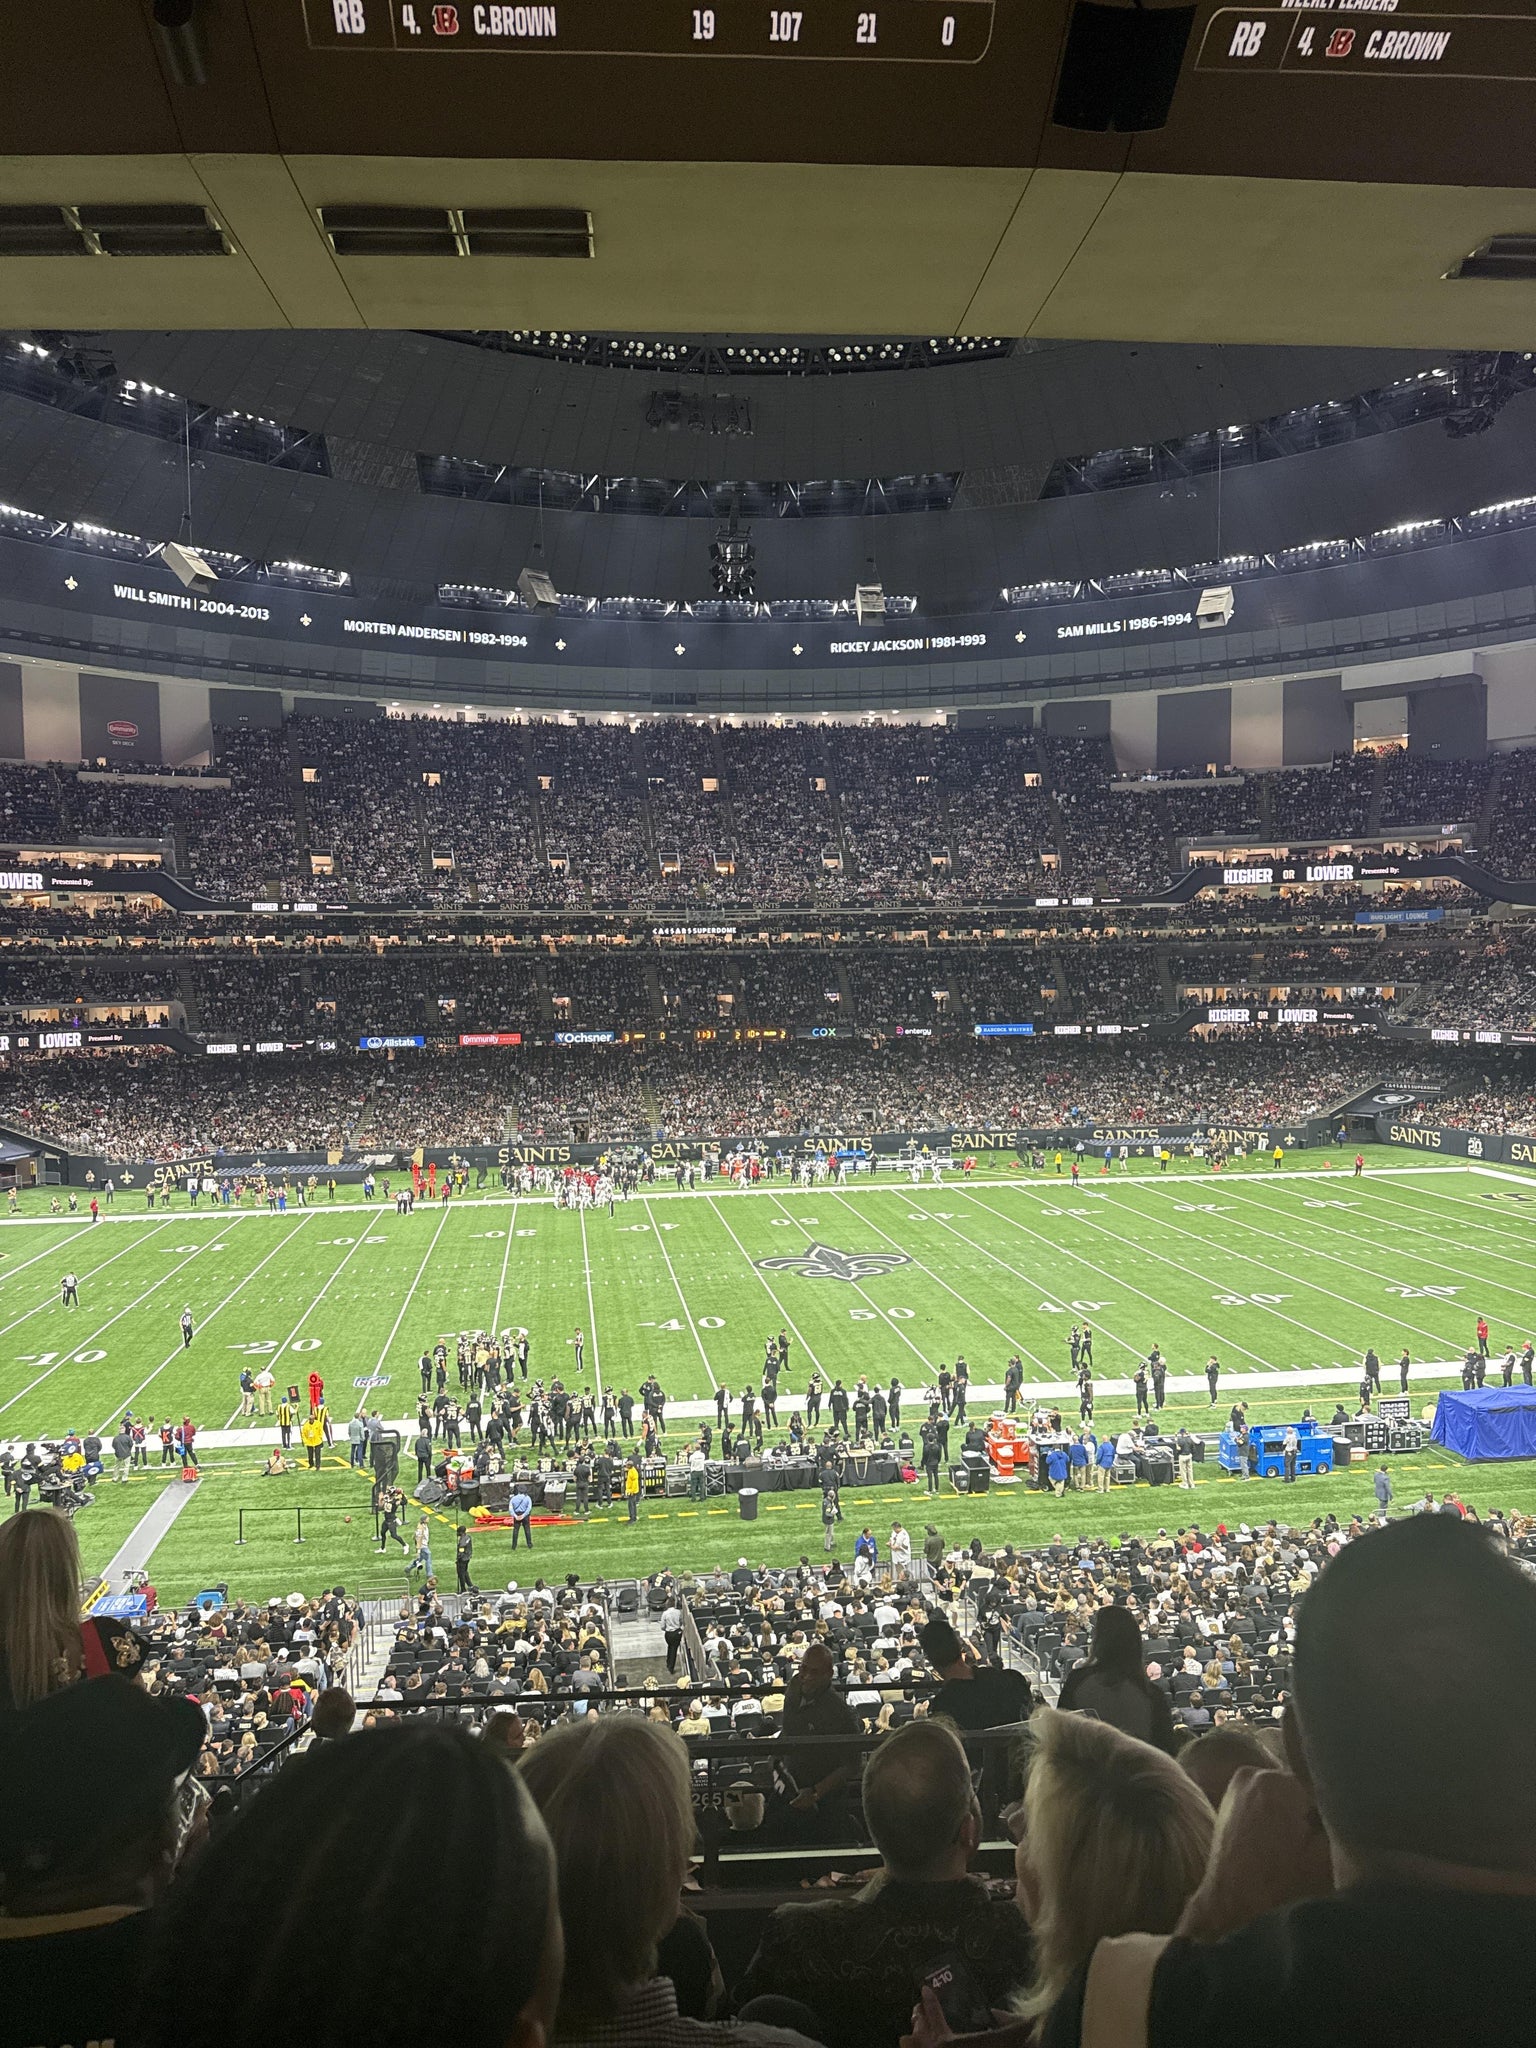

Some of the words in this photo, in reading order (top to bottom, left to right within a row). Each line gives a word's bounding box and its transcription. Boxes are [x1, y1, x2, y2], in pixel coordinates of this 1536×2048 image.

[335, 0, 366, 35] RB
[403, 7, 421, 35] 4.
[474, 5, 557, 37] C.BROWN
[693, 11, 715, 40] 19
[769, 12, 803, 42] 107
[856, 15, 877, 43] 21
[941, 16, 955, 46] 0
[1229, 22, 1266, 57] RB
[1298, 27, 1316, 56] 4.
[1364, 30, 1451, 61] C.BROWN
[114, 584, 147, 602] WILL
[148, 590, 191, 609] SMITH
[199, 600, 270, 621] 2004-2013
[1057, 624, 1082, 639] SAM
[1084, 620, 1121, 637] MILLS
[1128, 612, 1193, 630] 1986-1994
[344, 619, 396, 637] MORTEN
[398, 624, 461, 642] ANDERSEN
[468, 631, 528, 648] 1982-1994
[830, 640, 870, 654] RICKEY
[872, 637, 924, 653] JACKSON
[931, 633, 987, 649] 1981-1993
[52, 878, 81, 886] Presented
[1224, 868, 1273, 884] HIGHER
[1283, 870, 1295, 880] OR
[1306, 865, 1354, 882] LOWER
[1361, 867, 1389, 875] Presented
[1406, 912, 1428, 920] LOUNGE
[88, 928, 119, 936] SAINTS
[1209, 1009, 1250, 1022] HIGHER
[1258, 1011, 1269, 1020] OR
[1278, 1009, 1318, 1023] LOWER
[565, 1032, 612, 1043] Ochsner
[812, 1028, 836, 1036] COX
[905, 1028, 931, 1036] entergy
[1431, 1029, 1459, 1041] HIGHER
[1476, 1031, 1501, 1043] LOWER
[18, 1037, 29, 1047] OR
[40, 1032, 81, 1048] LOWER
[382, 1037, 417, 1047] Allstate
[463, 1035, 499, 1045] Community
[207, 1044, 237, 1054] HIGHER
[256, 1042, 284, 1052] LOWER
[951, 1132, 1017, 1148] SAINTS
[1207, 1128, 1269, 1147] AINTS
[1390, 1126, 1441, 1148] SAINTS
[804, 1137, 872, 1153] SAINTS
[498, 1145, 570, 1164] SAINTS
[154, 1159, 214, 1184] SAINTS
[1385, 1285, 1457, 1298] 20
[1037, 1300, 1102, 1313] 40
[1212, 1294, 1283, 1306] 30
[849, 1307, 916, 1321] 50
[658, 1316, 726, 1331] 40
[242, 1338, 322, 1355] 20
[28, 1350, 108, 1366] 10
[691, 1792, 722, 1806] 265
